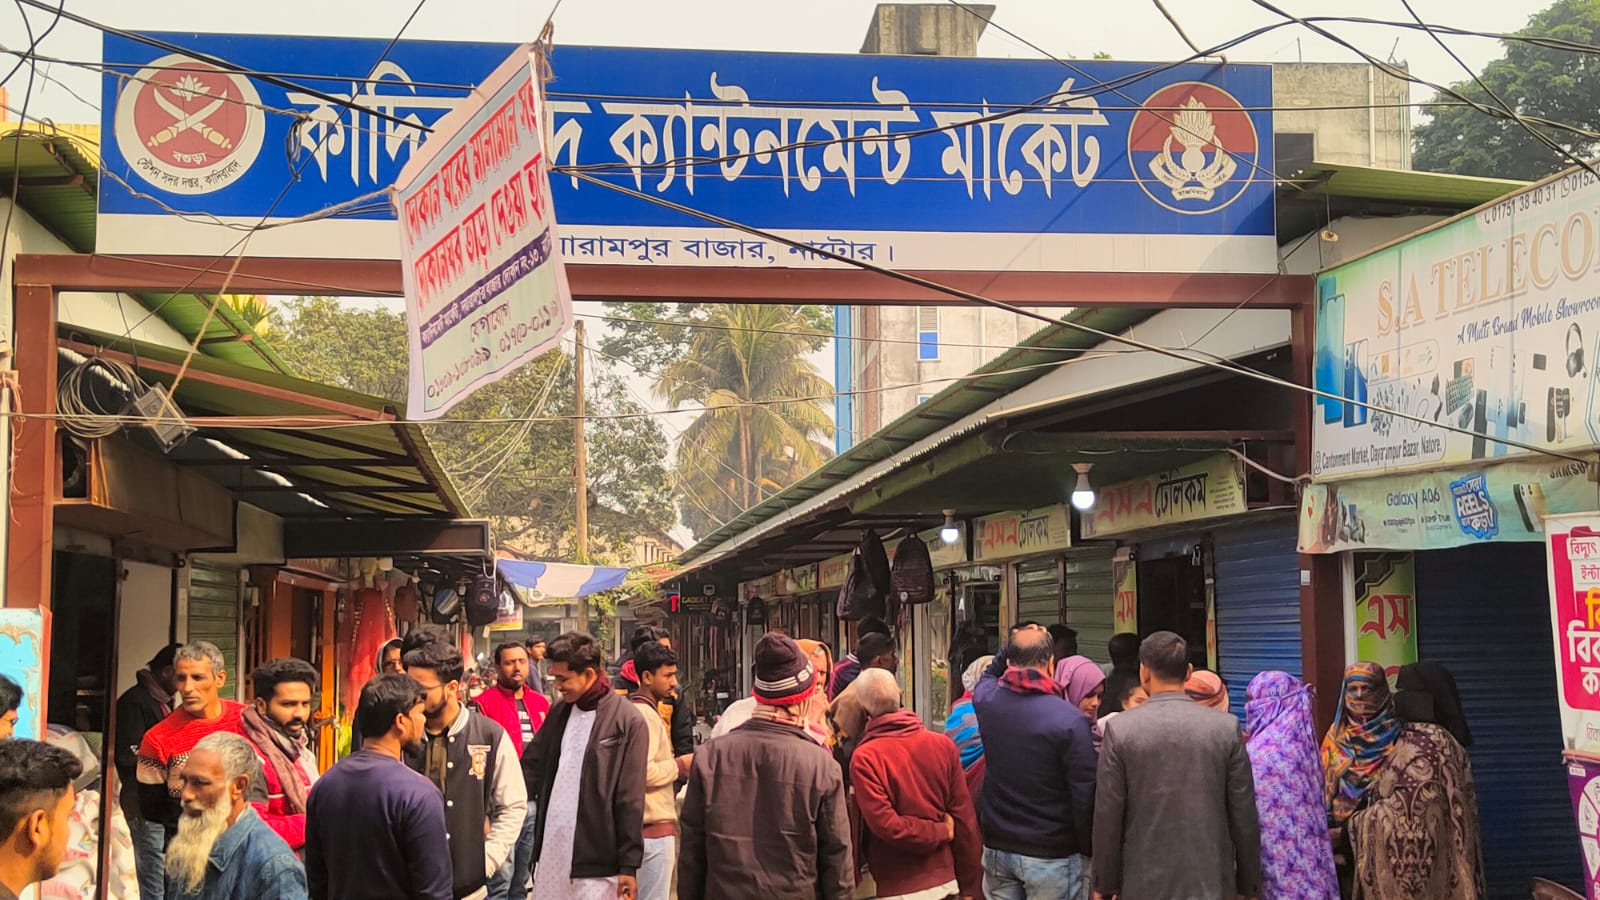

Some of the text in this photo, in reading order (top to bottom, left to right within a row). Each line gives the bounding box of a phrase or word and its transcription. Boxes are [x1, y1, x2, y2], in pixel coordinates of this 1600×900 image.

[601, 71, 920, 198] ক্যান্টনমেন্ট
[930, 77, 1109, 202] মার্কেট
[173, 151, 208, 165] বগুড়া
[1491, 198, 1516, 222] 01751
[1519, 193, 1530, 211] 38
[1532, 188, 1543, 206] 40
[1546, 184, 1556, 201] 31
[1430, 204, 1600, 320] TELECO
[1457, 323, 1465, 345] A
[1467, 319, 1490, 343] Multi
[1492, 313, 1518, 336] Brand
[1520, 300, 1553, 329] Mobile
[1322, 450, 1351, 469] Cantonment
[1154, 466, 1209, 518] টেলিকম
[1386, 491, 1418, 509] Galaxy
[1421, 487, 1441, 505] A06
[1456, 490, 1489, 517] REELS
[1360, 593, 1412, 640] এস
